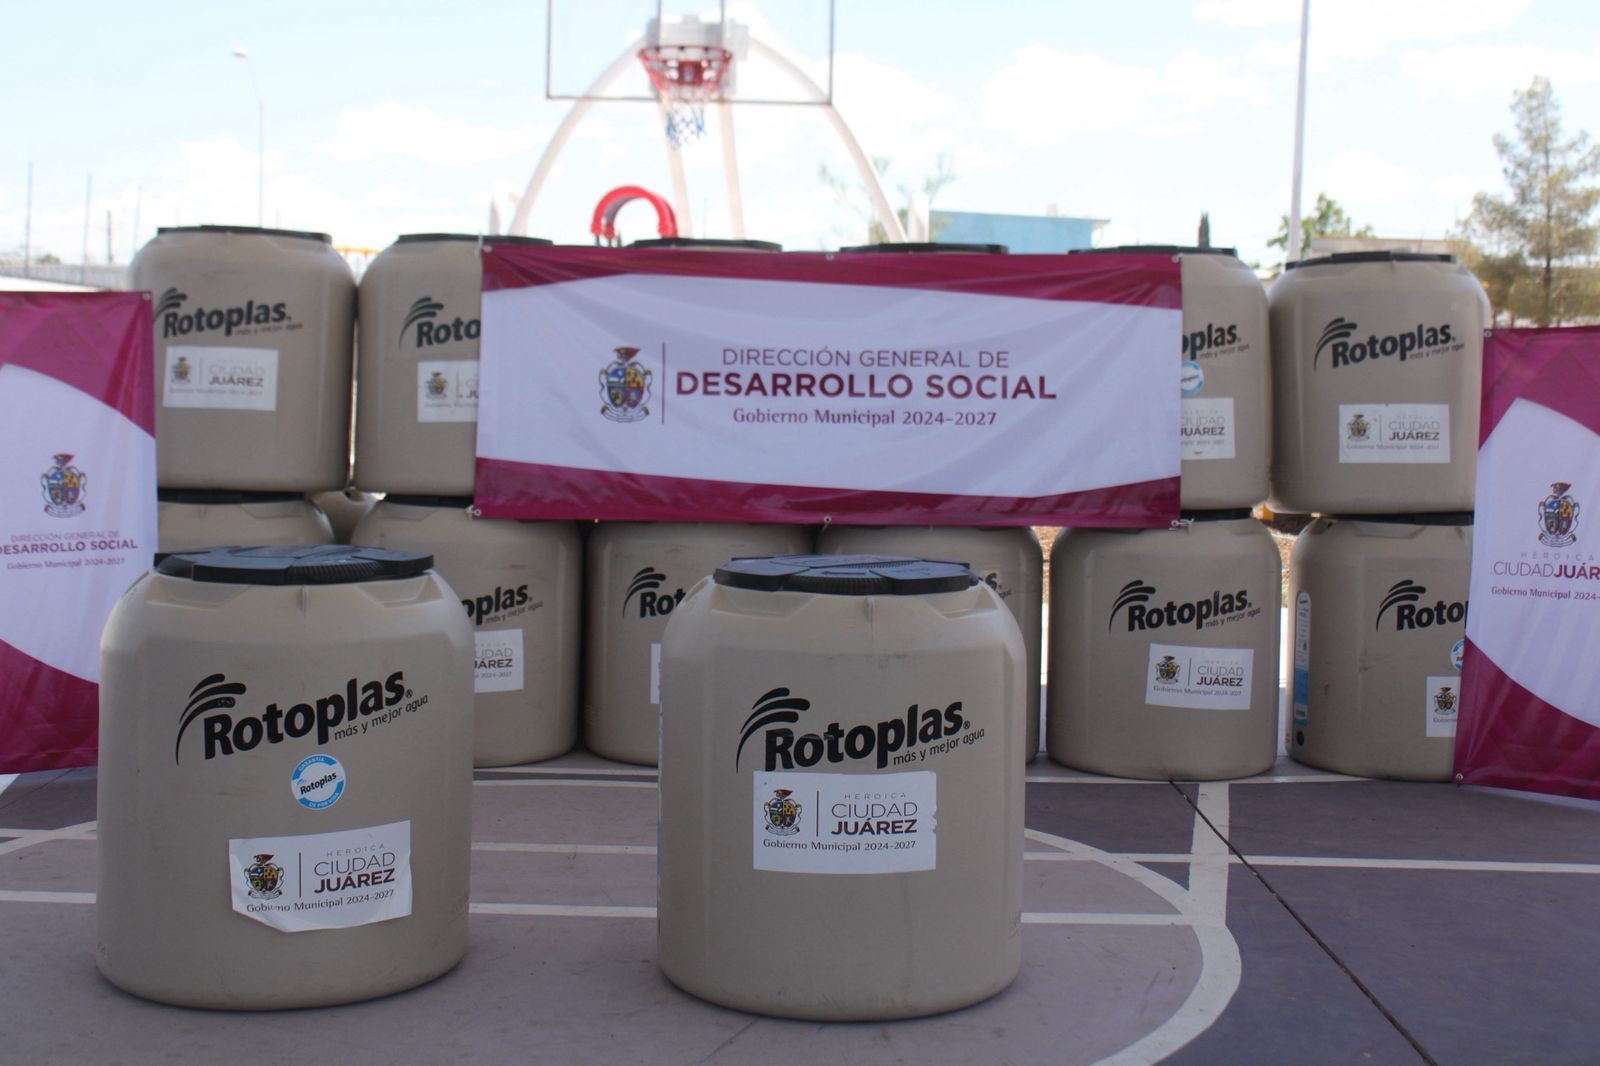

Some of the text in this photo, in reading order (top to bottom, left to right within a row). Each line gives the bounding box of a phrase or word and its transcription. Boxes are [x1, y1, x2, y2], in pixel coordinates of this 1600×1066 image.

[163, 299, 287, 339] Rotoplas
[722, 345, 1009, 368] DIRECCIÓN GENERAL DE
[1332, 323, 1451, 368] Rotoplas
[676, 371, 1057, 400] DESARROLLO SOCIAL
[733, 407, 997, 428] Gobierno Municipal 2024-2027
[1389, 429, 1441, 441] JUÁREZ
[90, 539, 138, 551] SOCIAL
[1491, 586, 1527, 597] Gobierno
[1530, 588, 1571, 600] Municipal
[1128, 589, 1247, 632] Rotoplas
[1197, 675, 1243, 687] JUÁREZ
[1198, 665, 1245, 677] CIUDAD
[334, 694, 428, 741] más y mejor agua
[893, 728, 985, 766] más y mejor agua
[300, 772, 337, 795] Rotoplas
[845, 792, 907, 800] HEROICA
[831, 802, 918, 819] CIUDAD
[831, 817, 918, 836] JUÁREZ
[326, 843, 385, 857] HEROICA
[763, 838, 916, 853] Gobierno Municipal 2024-2027
[314, 852, 396, 877] CIUDAD
[314, 868, 395, 894] JUÁREZ
[294, 897, 343, 912] Municipal
[346, 889, 395, 905] 2024-2027
